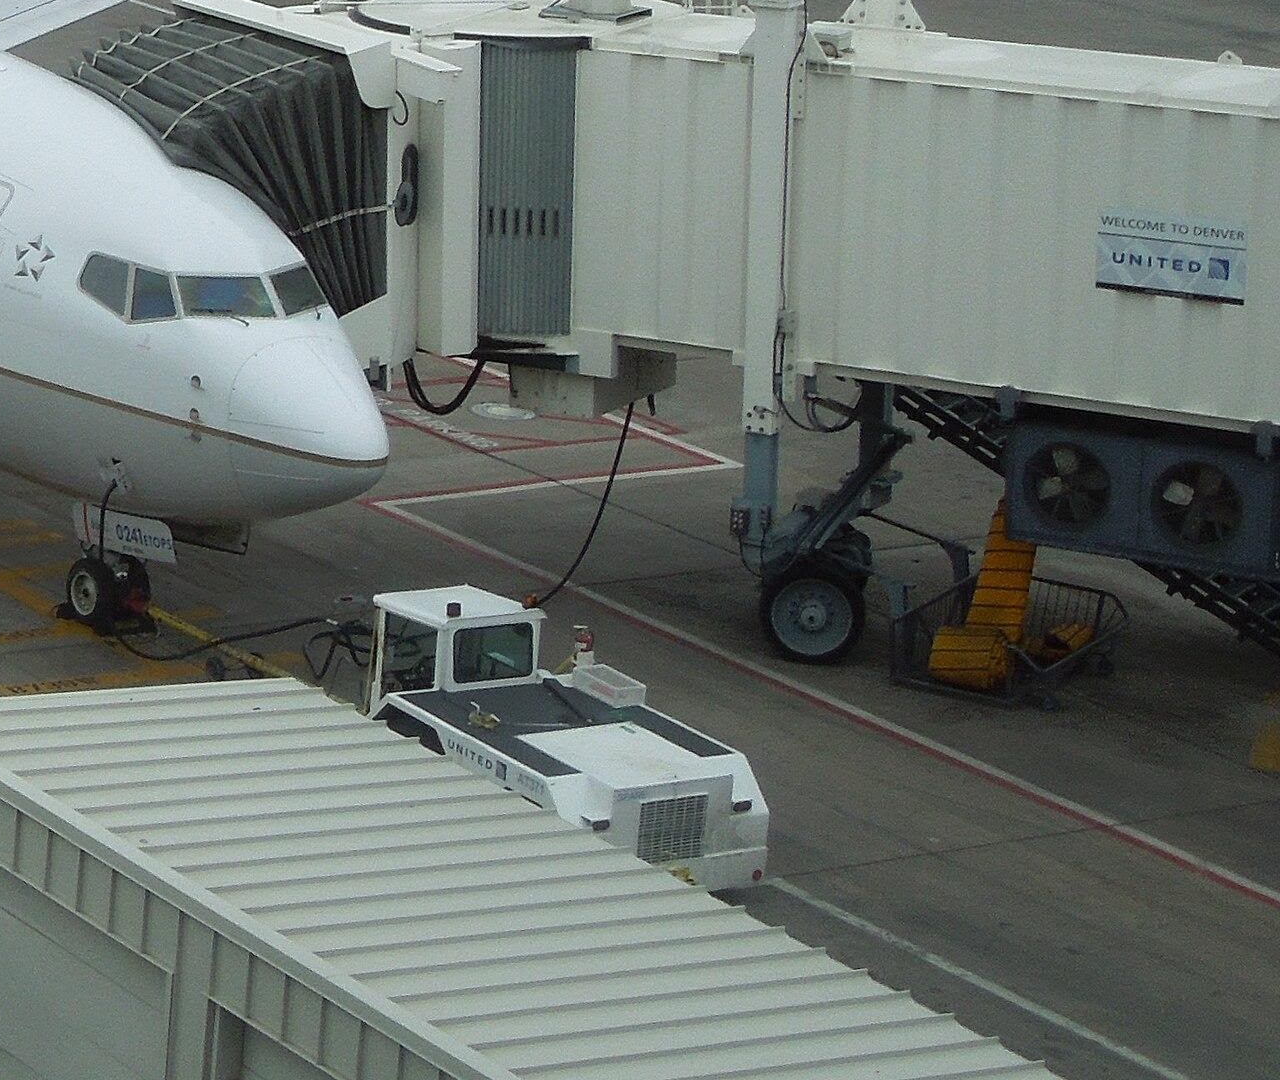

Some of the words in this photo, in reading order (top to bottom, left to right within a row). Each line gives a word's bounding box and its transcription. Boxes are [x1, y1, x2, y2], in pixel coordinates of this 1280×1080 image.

[1100, 215, 1166, 233] WELCOME
[1170, 223, 1190, 235] TO
[1192, 226, 1245, 241] DENVER
[1112, 251, 1202, 273] UNITED
[115, 523, 144, 545] 0241
[447, 738, 493, 770] UNITED
